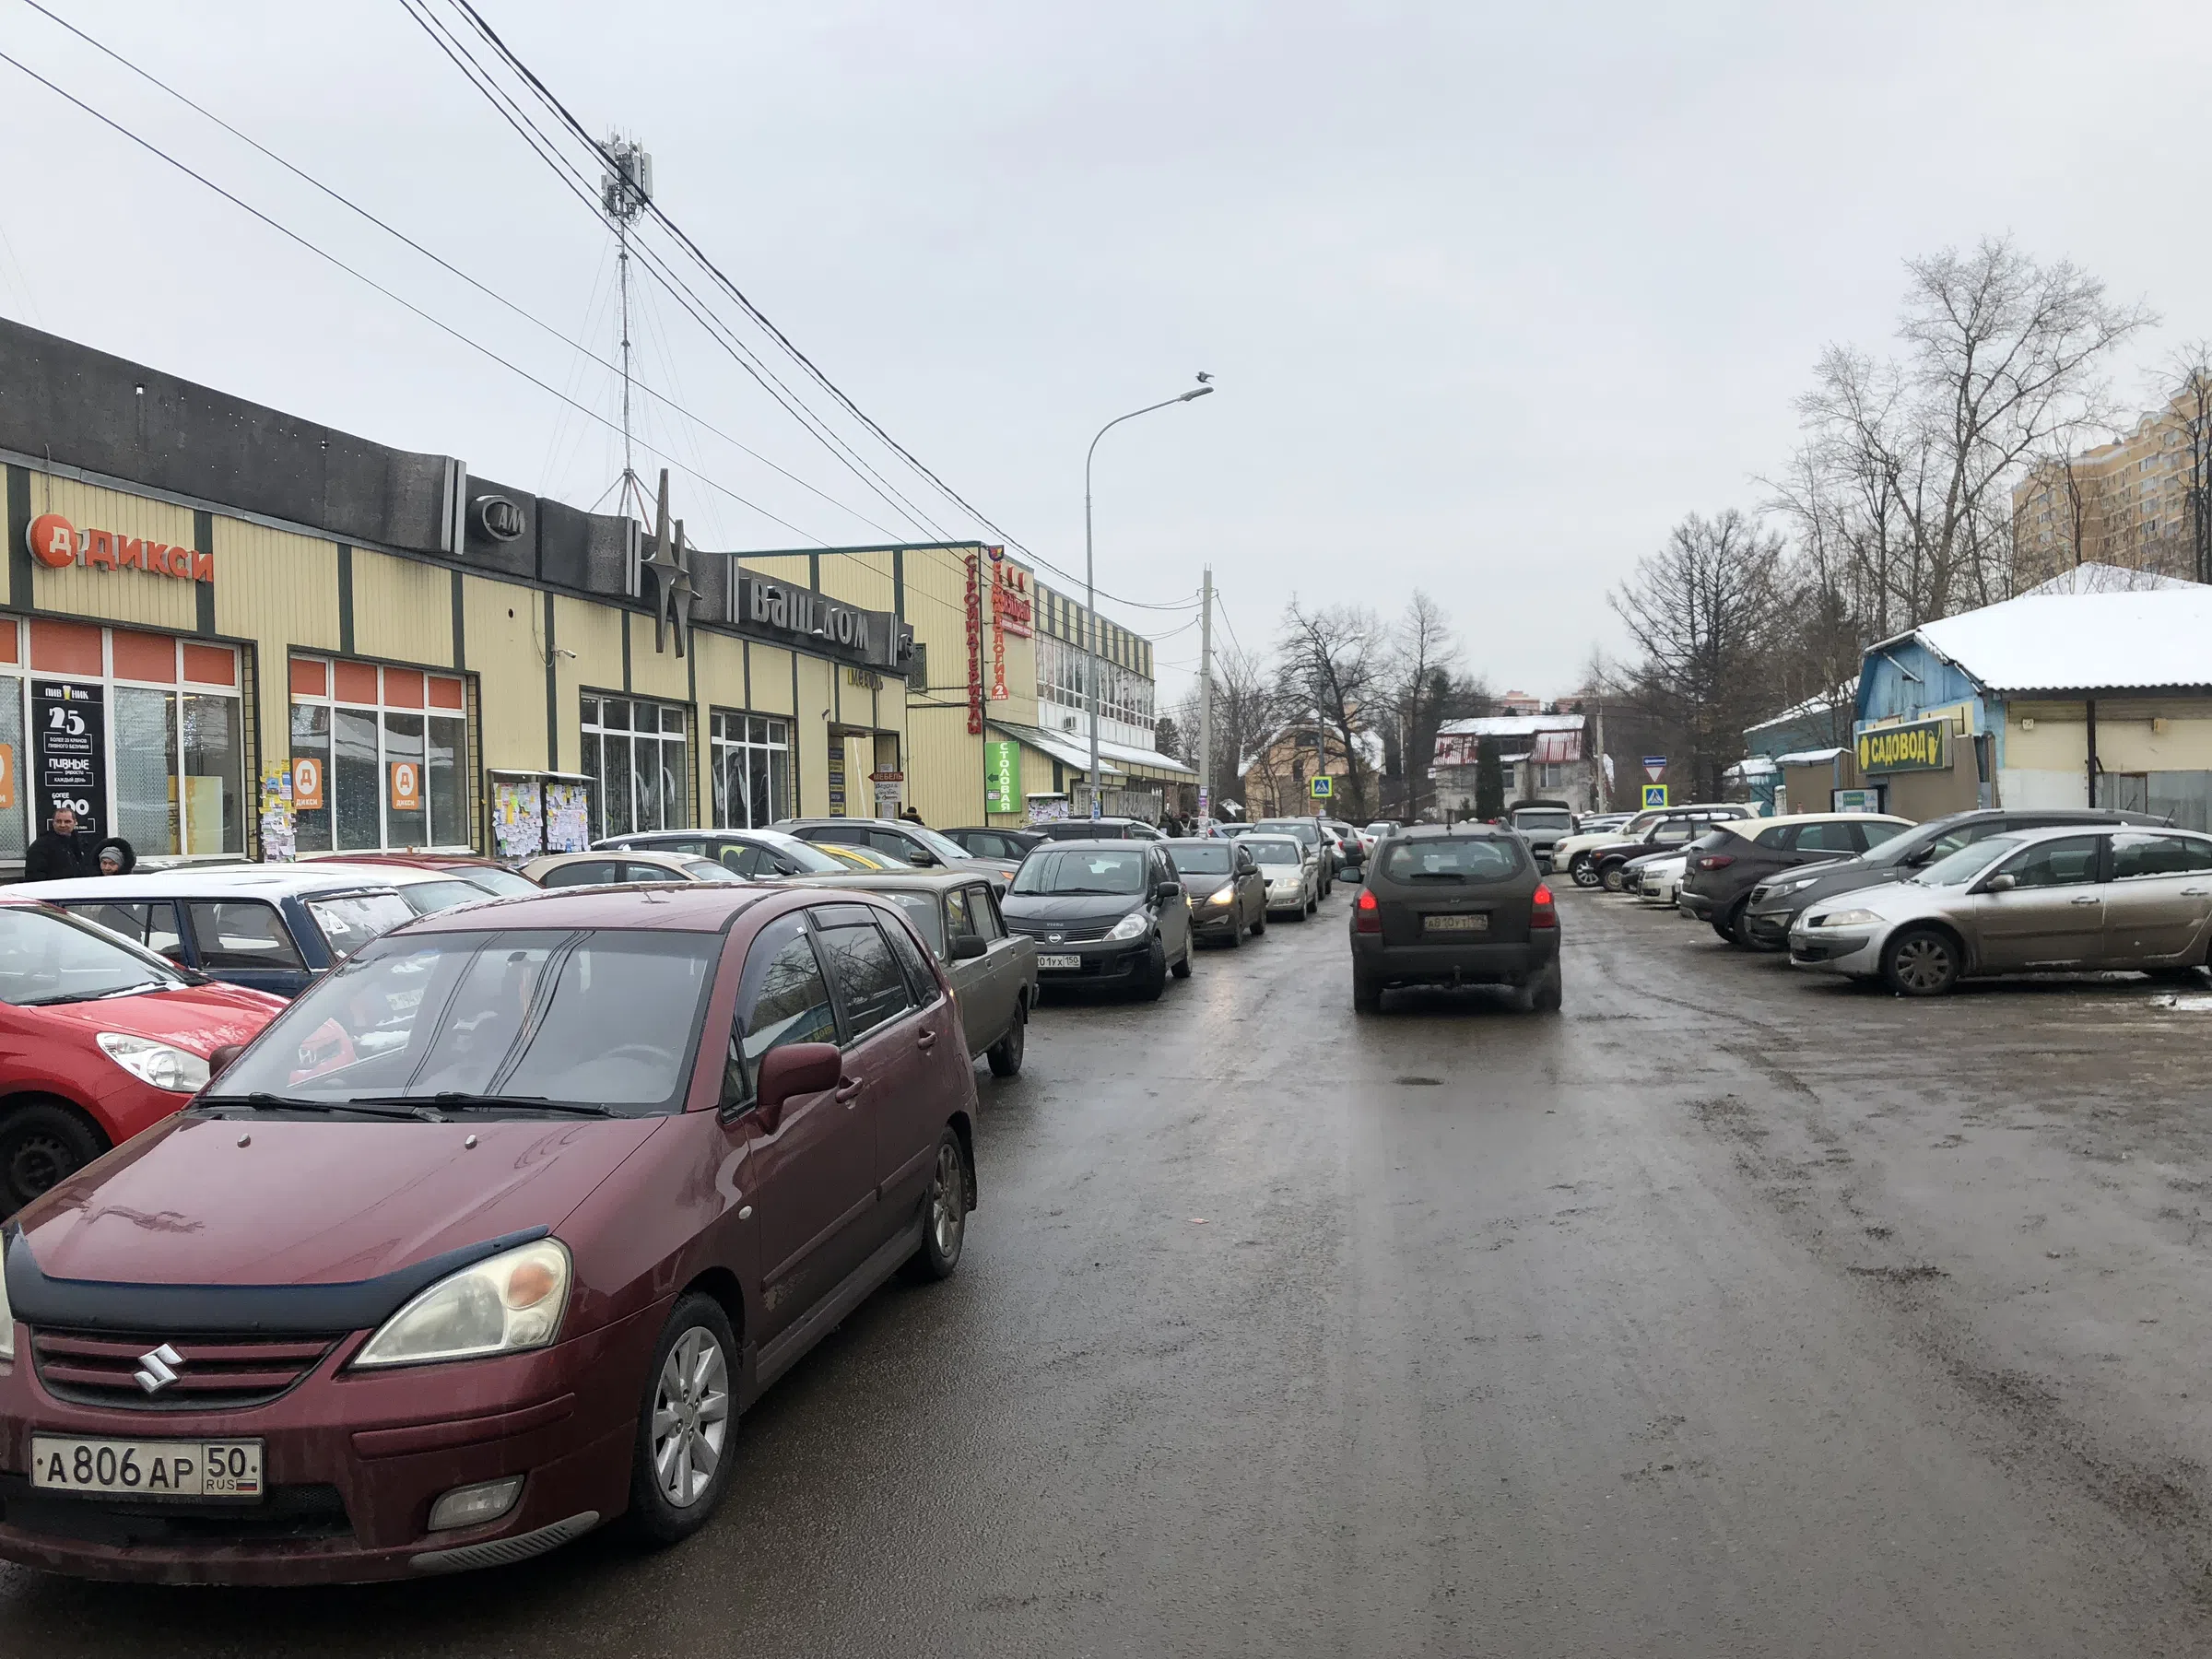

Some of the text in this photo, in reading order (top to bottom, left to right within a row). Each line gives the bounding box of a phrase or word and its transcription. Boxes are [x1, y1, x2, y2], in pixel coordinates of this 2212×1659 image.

[85, 528, 214, 582] ДИКСИ
[964, 555, 982, 734] СТРОЙМАТЕРИАЛЫ
[995, 685, 1004, 695] 2
[49, 707, 85, 735] 25
[1871, 730, 1926, 767] САДОВОД
[999, 742, 1011, 811] СТОЛОВАЯ
[1065, 956, 1078, 965] 150
[207, 1447, 246, 1477] 50
[206, 1479, 235, 1490] RUS
